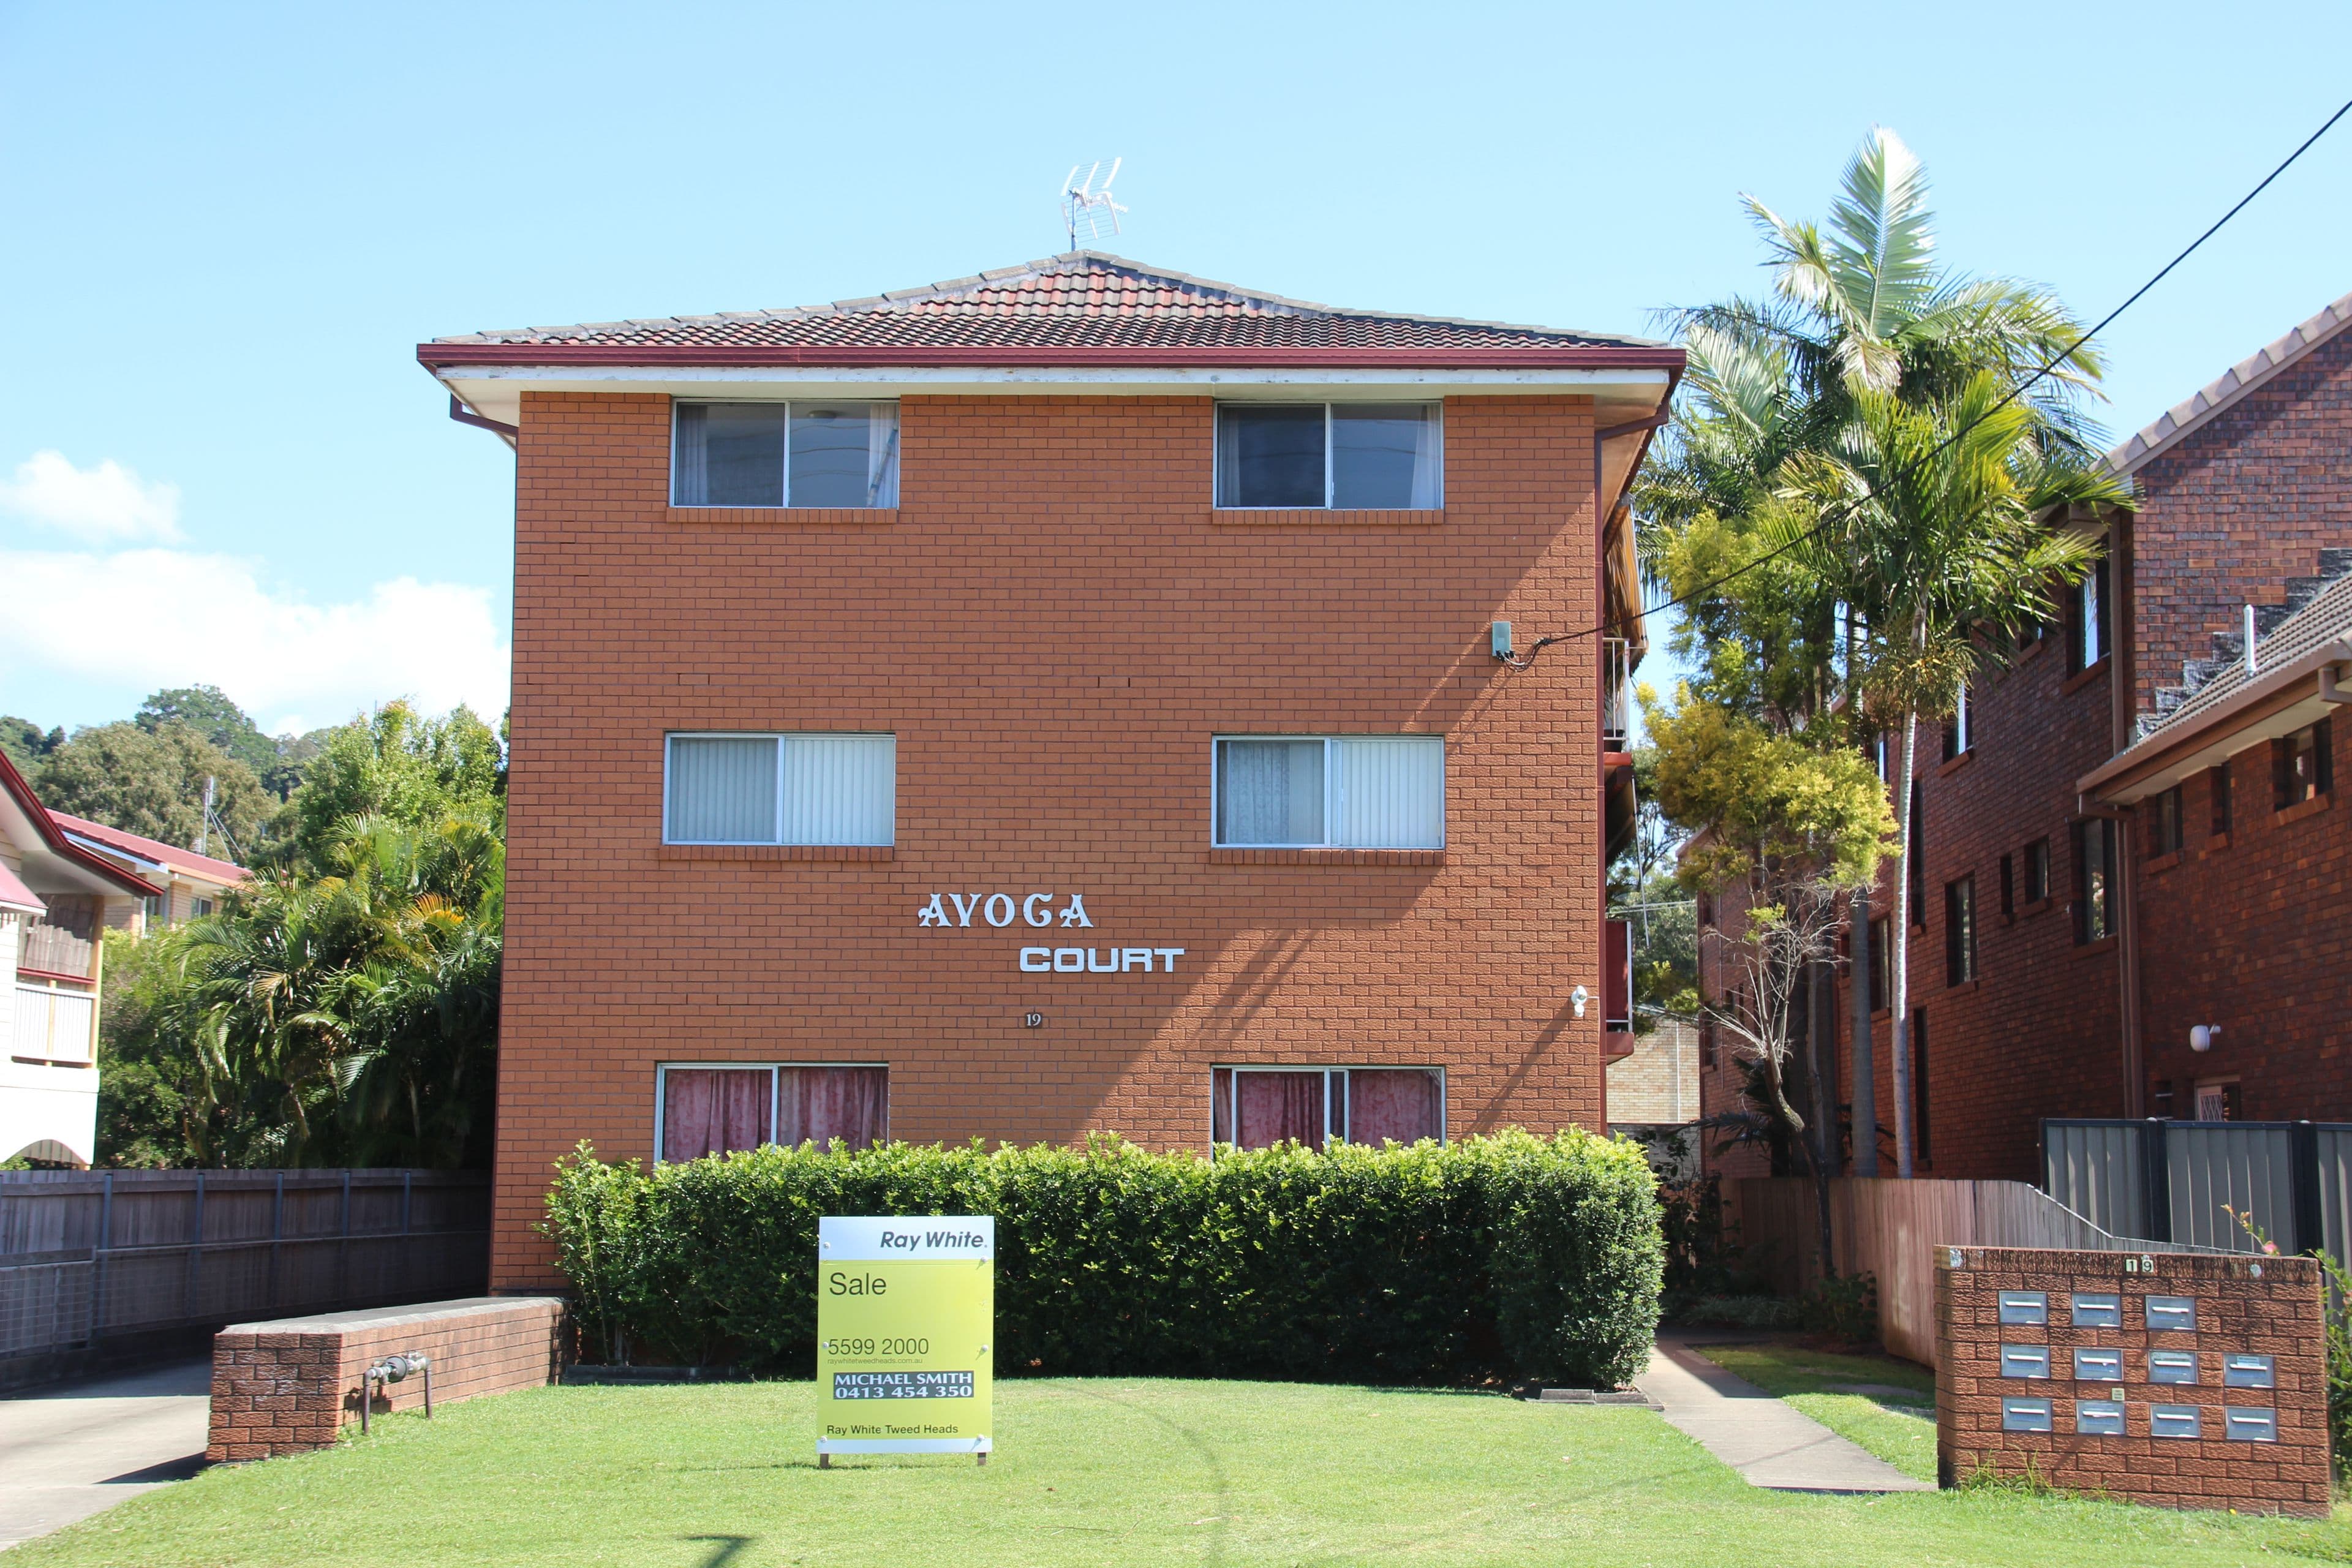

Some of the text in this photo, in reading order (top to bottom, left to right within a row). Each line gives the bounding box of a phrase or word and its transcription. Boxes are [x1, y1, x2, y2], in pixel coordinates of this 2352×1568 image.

[1020, 947, 1185, 972] COURT
[1027, 1014, 1041, 1026] 19
[880, 1231, 921, 1251] Ray
[2129, 1261, 2152, 1272] 19
[829, 1272, 886, 1295] Sale
[828, 1338, 929, 1355] 5599 2000
[835, 1373, 972, 1385] MICHAEL SMITH
[835, 1385, 973, 1398] 0413 454 350
[827, 1424, 959, 1436] Ray White Tweed Heads
